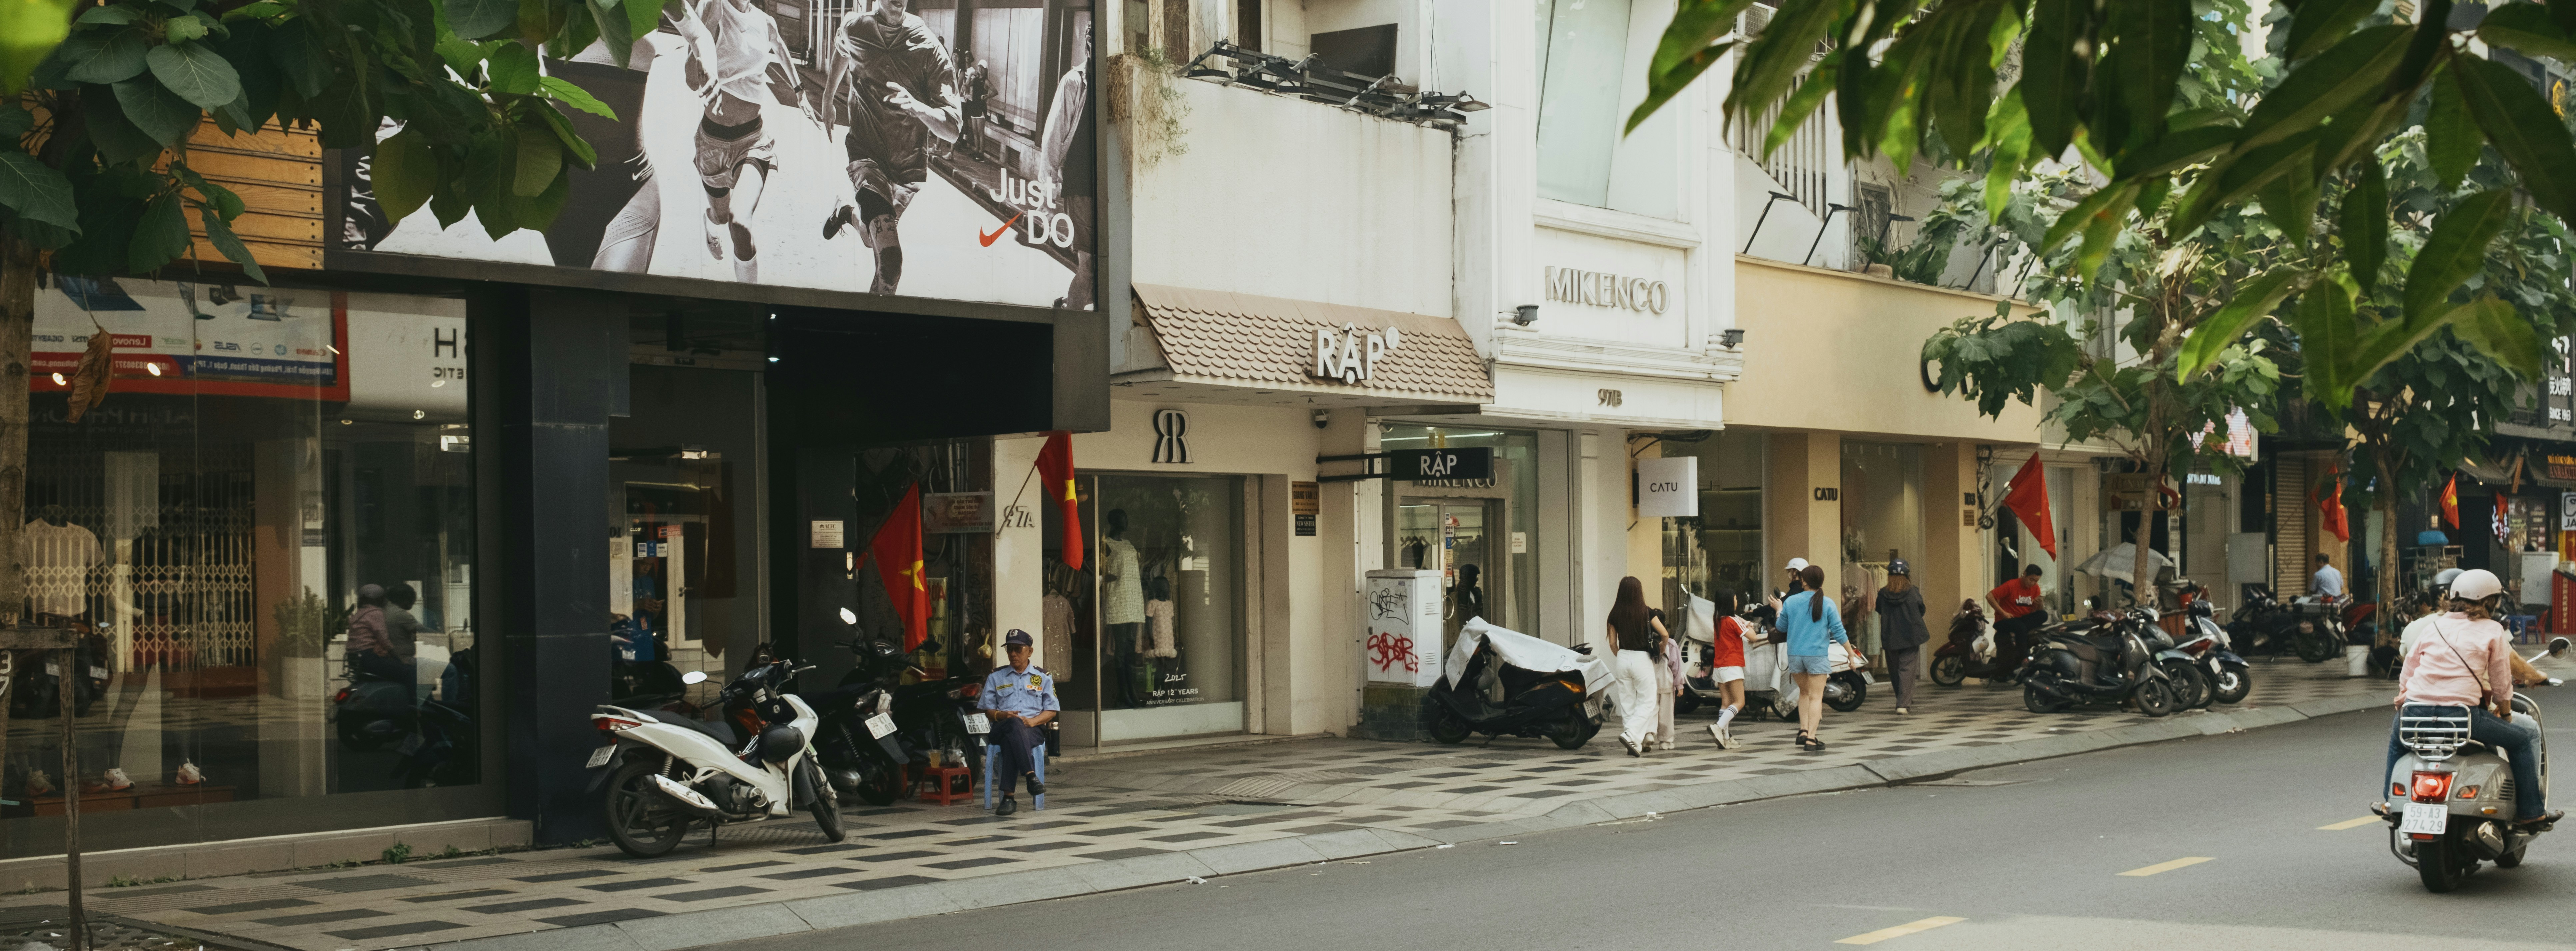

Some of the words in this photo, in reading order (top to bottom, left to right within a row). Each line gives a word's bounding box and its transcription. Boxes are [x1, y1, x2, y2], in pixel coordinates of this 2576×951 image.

[989, 168, 1056, 209] Just
[1028, 209, 1075, 248] DO
[1545, 266, 1671, 315] MIKENCO
[1312, 321, 1384, 384] RẬP
[1598, 388, 1622, 407] 97B
[1420, 451, 1457, 477] RẬP
[1650, 482, 1678, 492] CATU
[1814, 487, 1838, 501] CATU
[1003, 504, 1035, 528] 97A
[1164, 673, 1187, 682] 2025
[1153, 689, 1165, 697] RẬP
[869, 715, 887, 728] 59-K1
[872, 722, 895, 737] 521.00
[2410, 807, 2440, 819] 59-A3
[2404, 819, 2443, 832] 274.29
